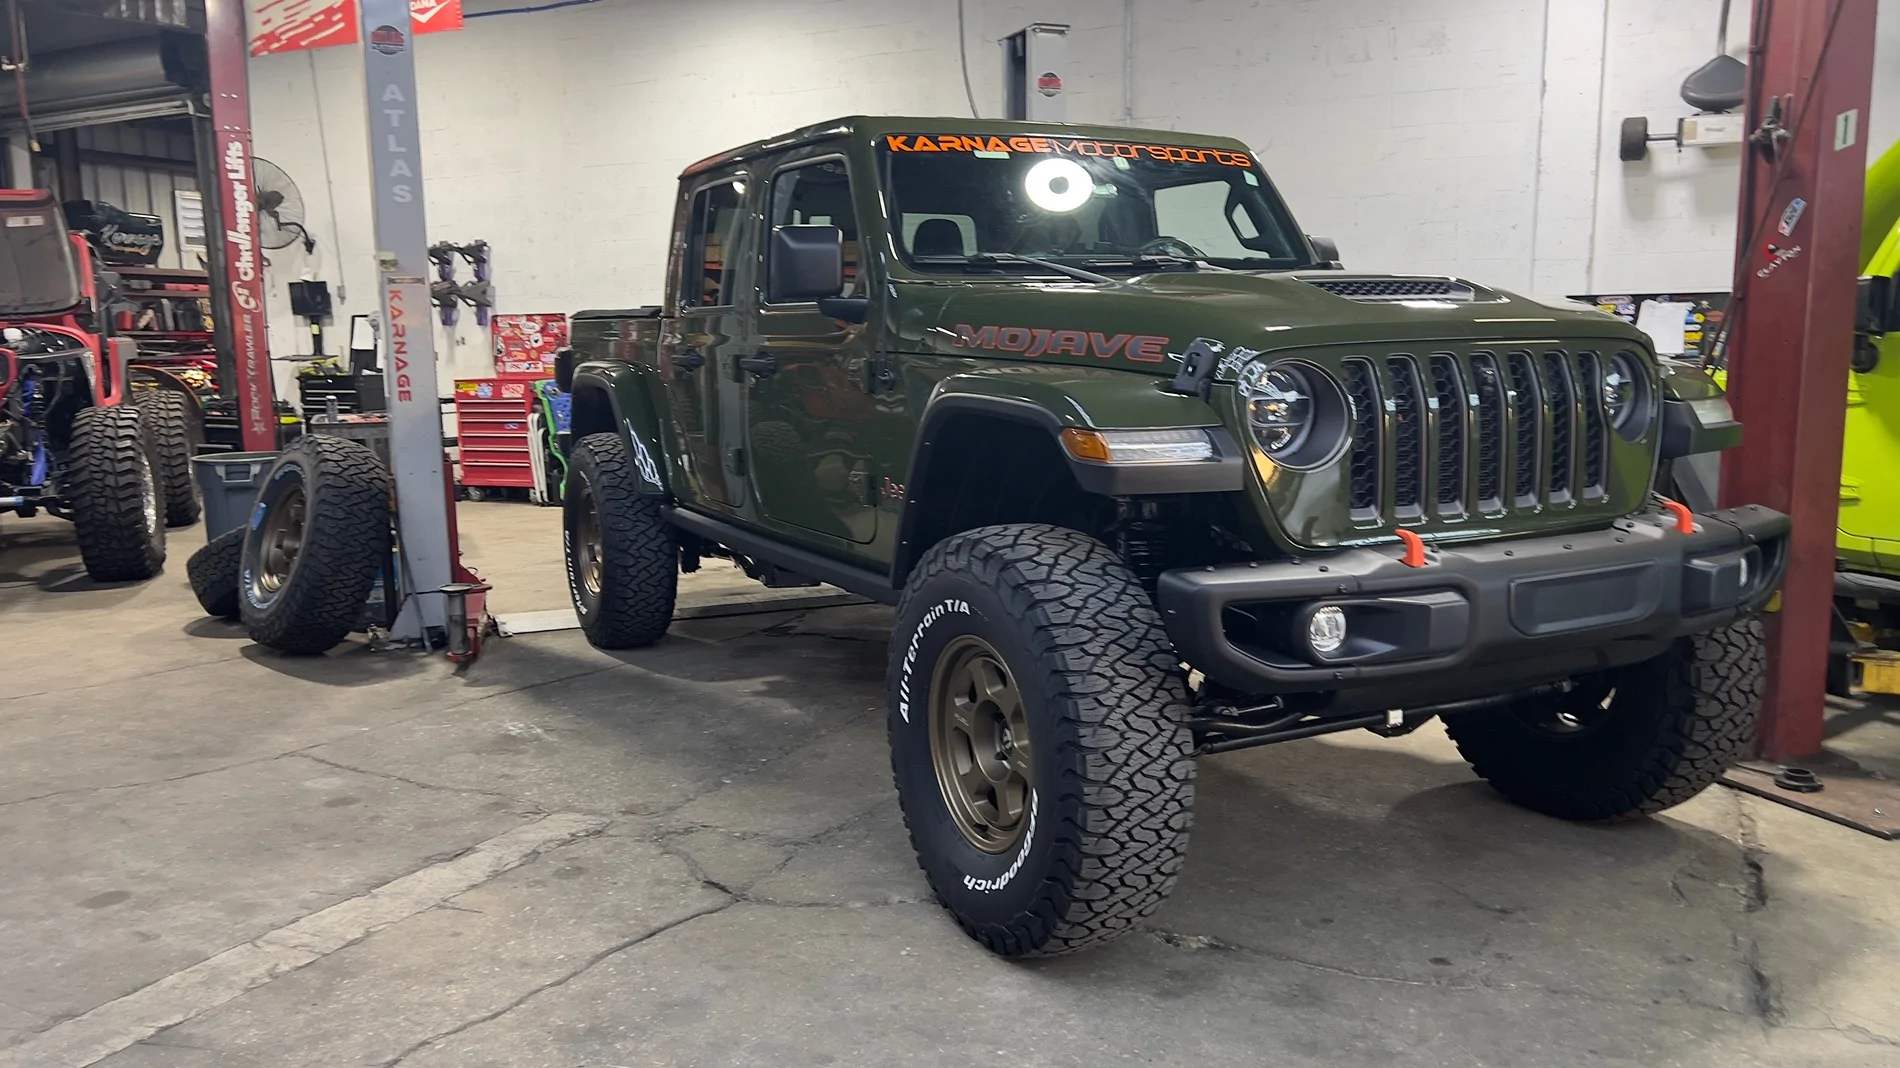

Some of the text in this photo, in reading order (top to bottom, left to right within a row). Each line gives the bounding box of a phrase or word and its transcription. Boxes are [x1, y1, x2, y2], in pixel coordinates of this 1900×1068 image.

[382, 83, 413, 202] ATLAS
[886, 135, 1251, 167] KARNAGE Motorsports
[388, 289, 412, 403] KARNAGE
[953, 323, 1170, 363] MOJAVE
[899, 604, 946, 724] All-Terrain
